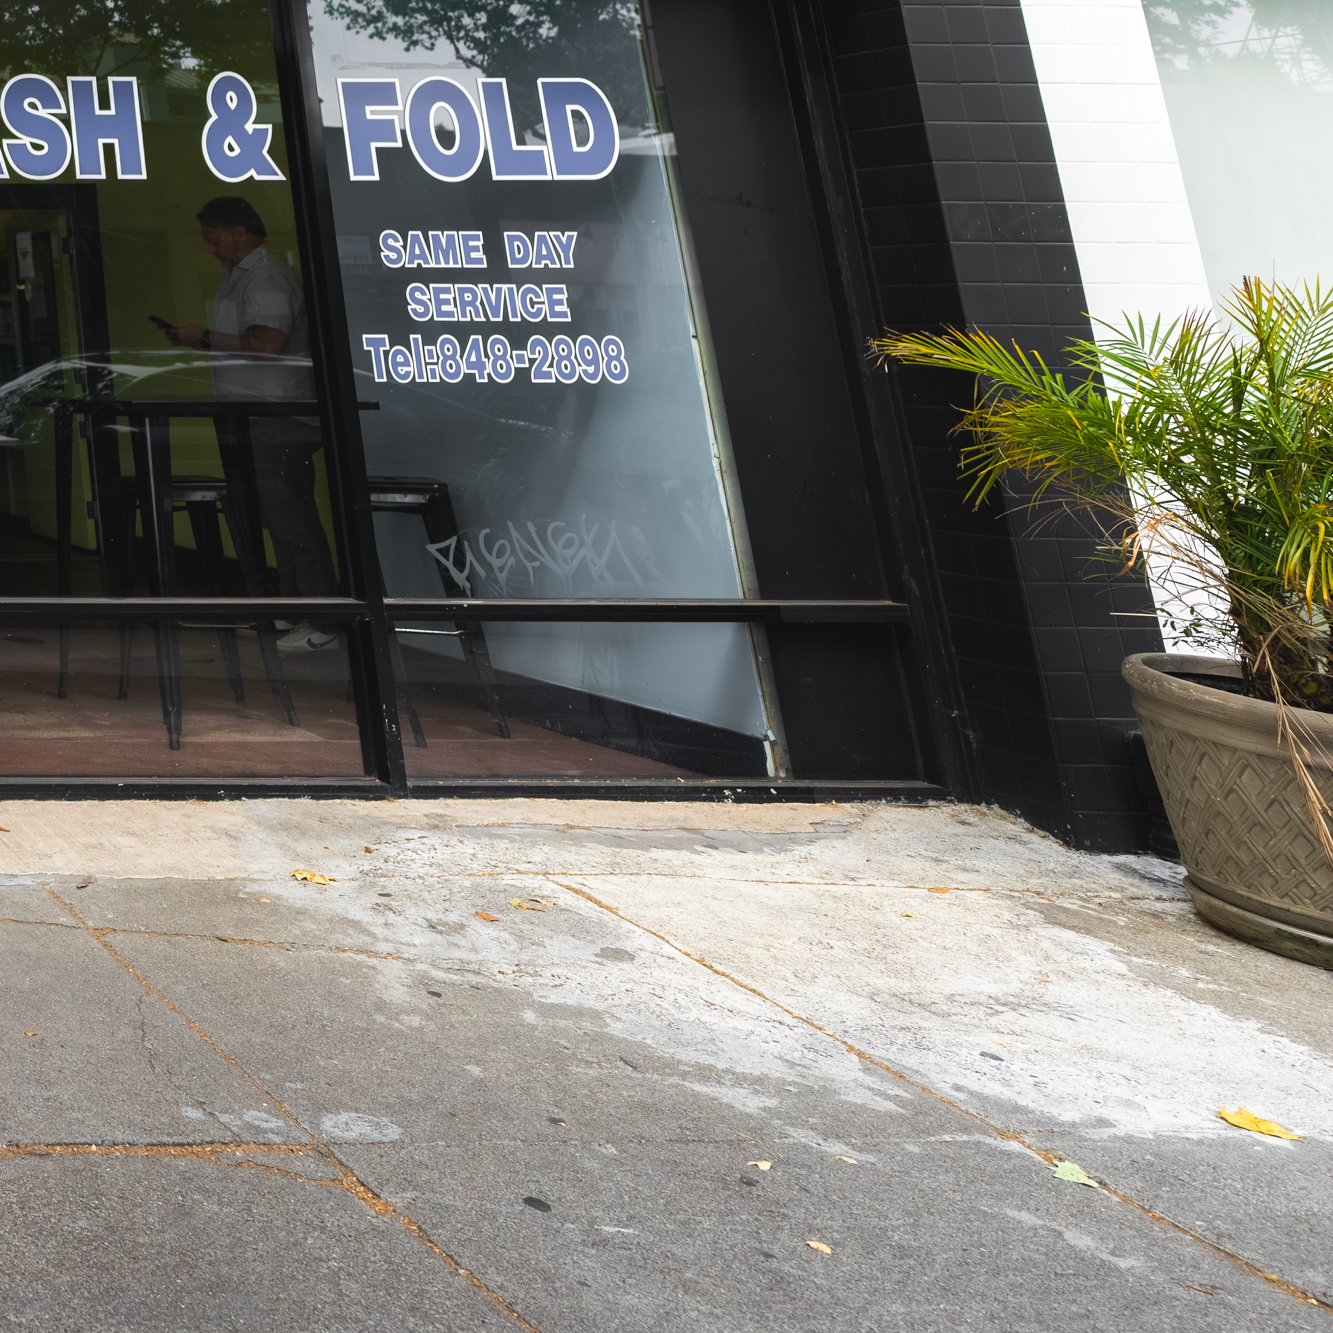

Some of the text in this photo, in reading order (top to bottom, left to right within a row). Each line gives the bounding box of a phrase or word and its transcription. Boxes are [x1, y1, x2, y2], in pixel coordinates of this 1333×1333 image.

[200, 70, 287, 183] &
[336, 74, 621, 183] FOLD
[379, 229, 488, 268] SAME
[504, 230, 578, 268] DAY
[405, 282, 572, 322] SERVICE
[362, 333, 629, 384] Tel:848-2898
